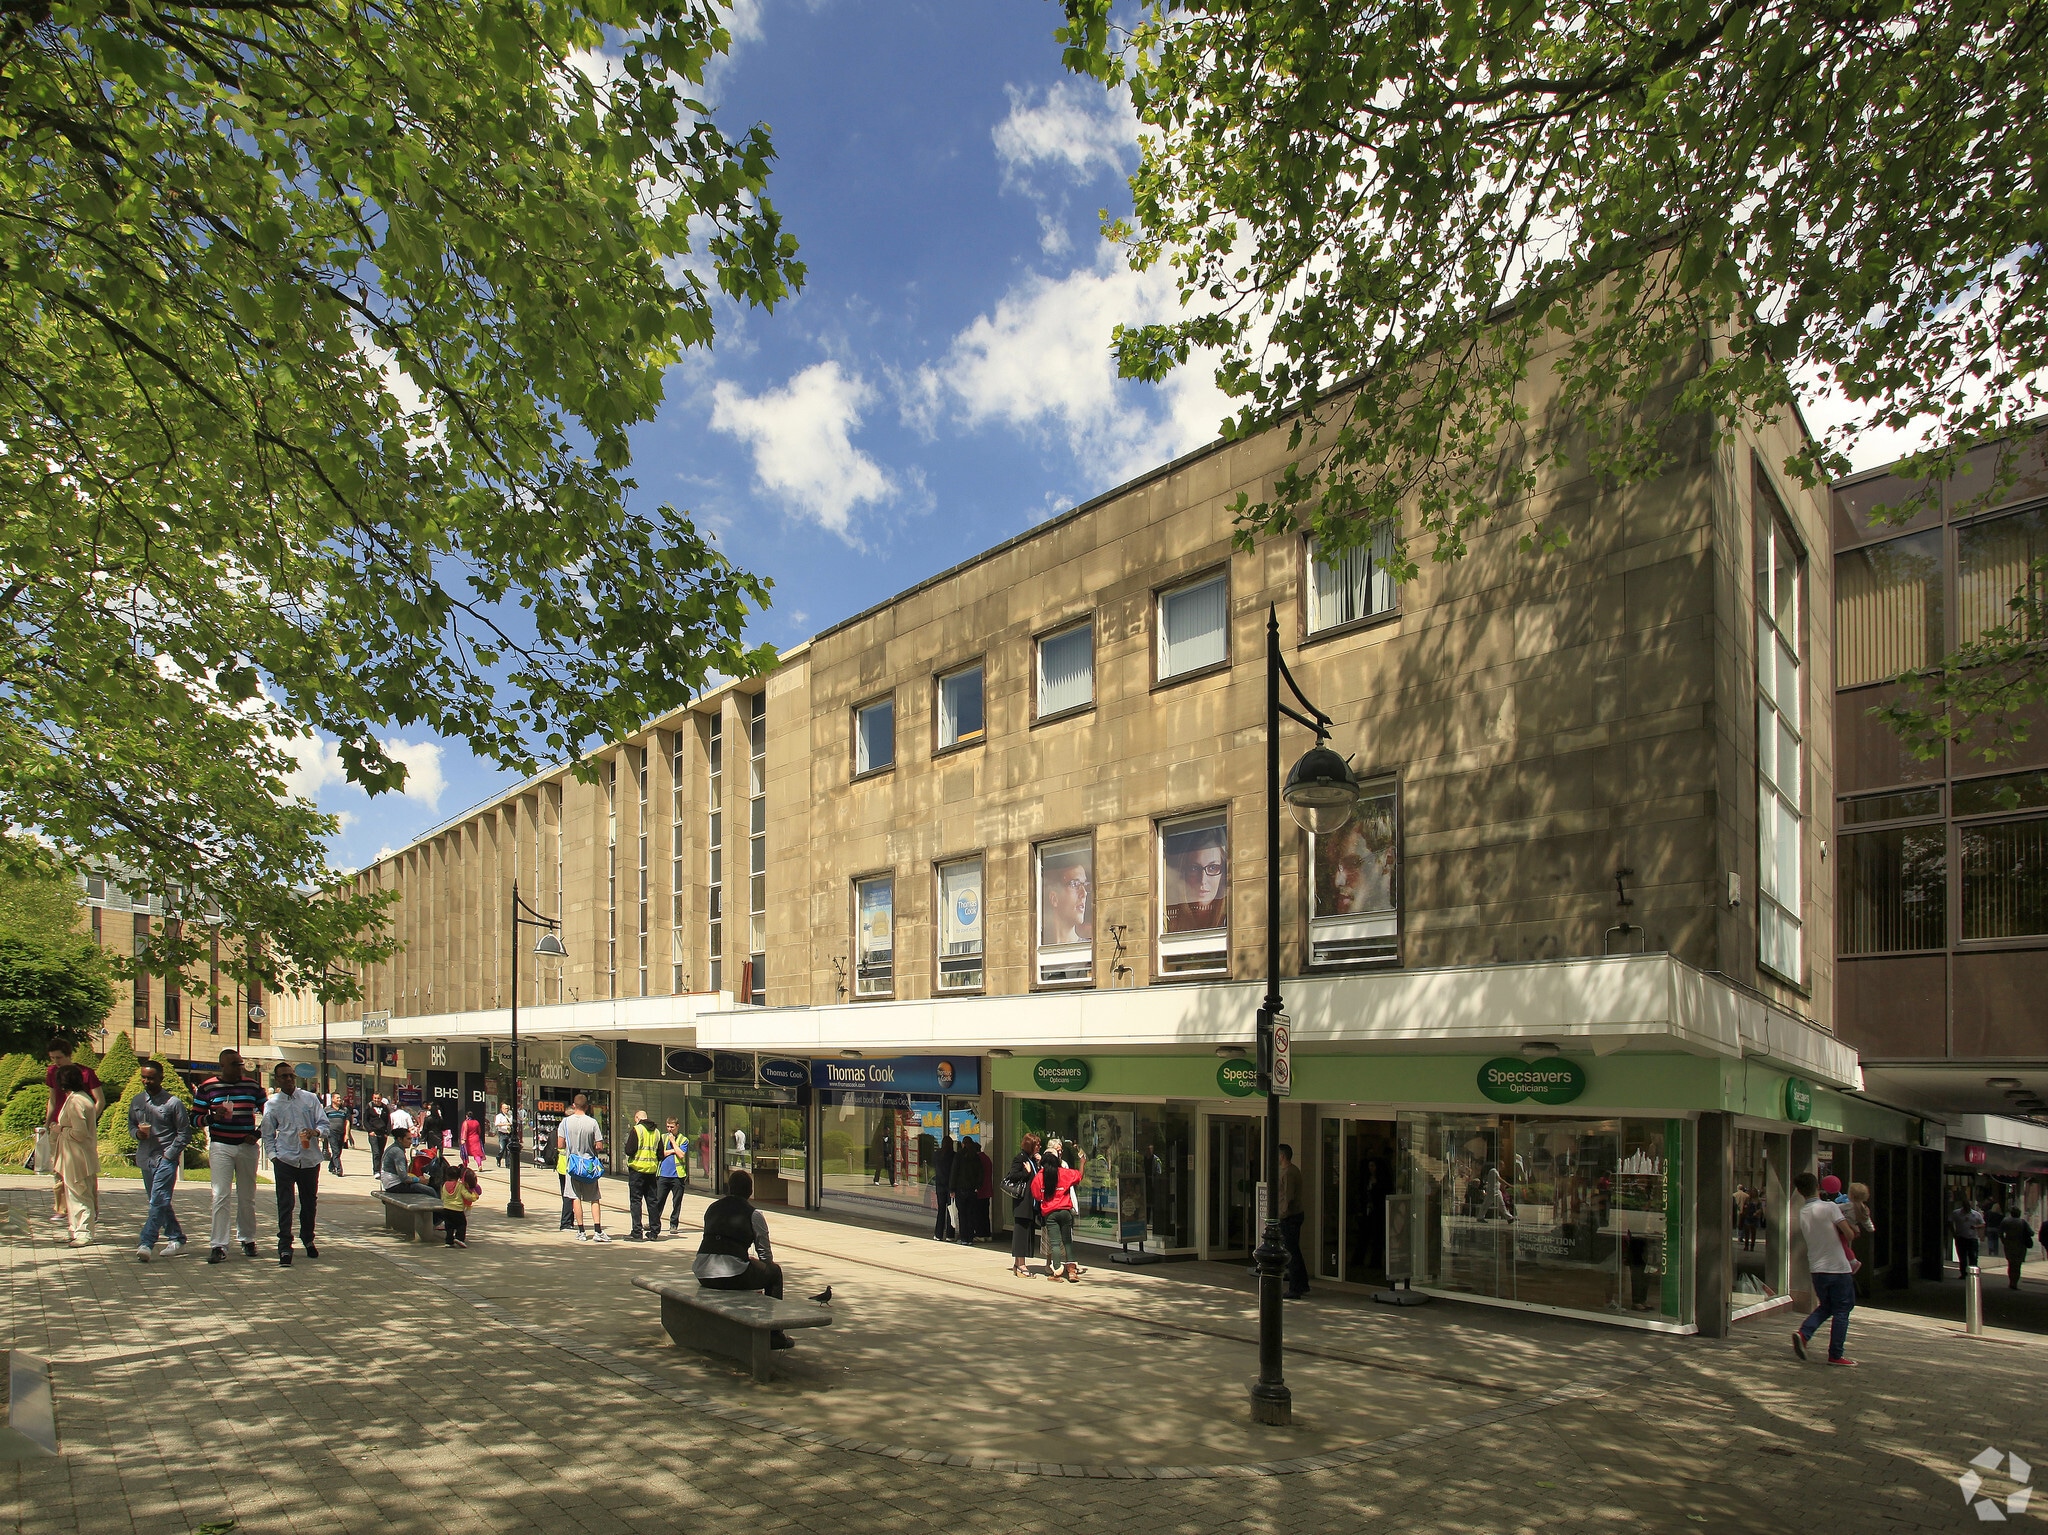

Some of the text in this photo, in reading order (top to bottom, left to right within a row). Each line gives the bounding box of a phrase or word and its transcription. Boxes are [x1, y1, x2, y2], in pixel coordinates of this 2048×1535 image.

[958, 900, 977, 909] Thomas
[964, 907, 977, 916] Cook
[431, 1045, 446, 1067] BHS
[528, 1059, 563, 1080] footaction
[766, 1068, 803, 1079] Thomas Cook
[826, 1064, 895, 1082] Thomas Cook
[1038, 1066, 1082, 1078] Specsavers
[1049, 1076, 1070, 1084] Opticians
[1488, 1068, 1572, 1085] Specsavers
[434, 1086, 459, 1099] BHS
[1509, 1083, 1549, 1093] Opticians
[537, 1100, 565, 1112] OFFER
[1519, 1233, 1576, 1247] PRESCRIPTION
[1519, 1242, 1569, 1256] SUNGLASSES
